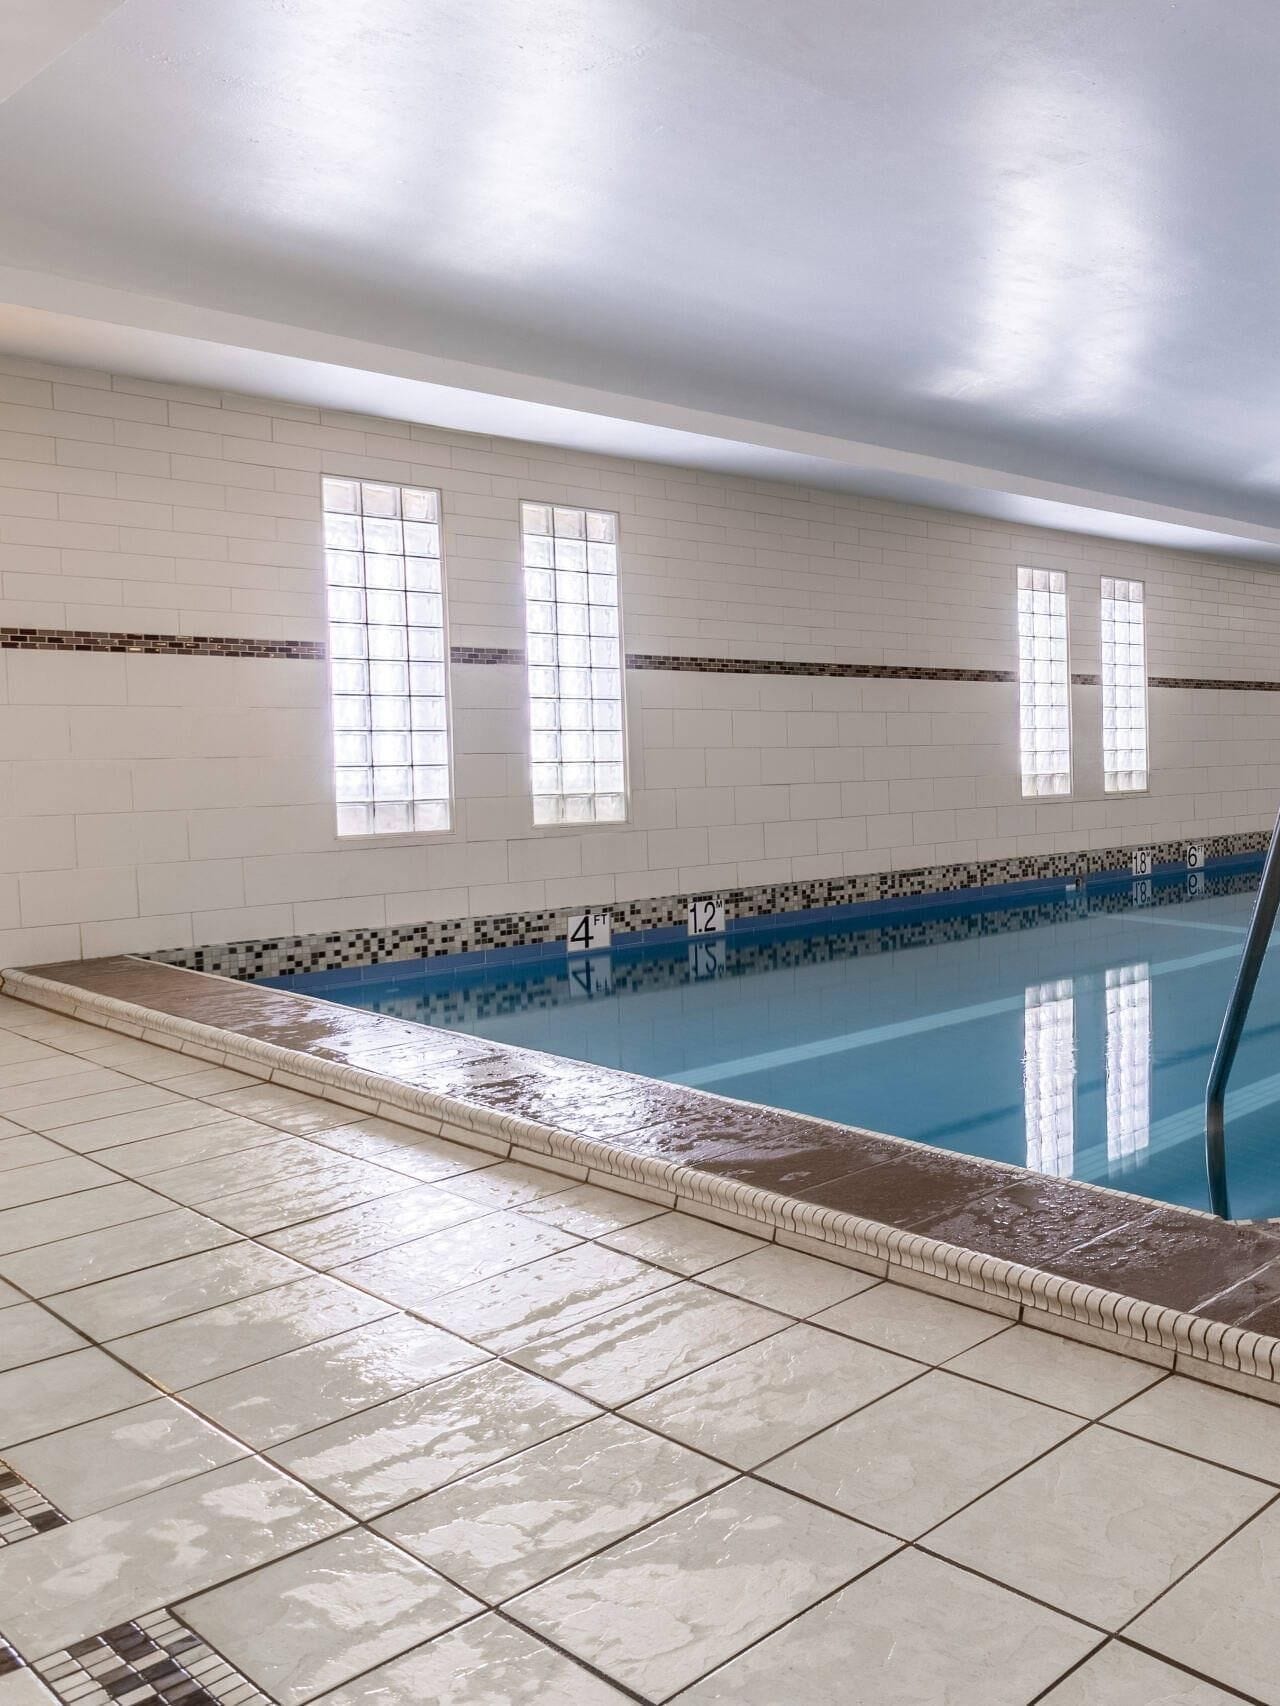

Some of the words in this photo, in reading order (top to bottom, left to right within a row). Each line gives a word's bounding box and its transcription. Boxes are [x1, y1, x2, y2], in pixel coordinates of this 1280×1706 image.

[1133, 852, 1147, 875] 1.8
[1188, 846, 1197, 867] 6
[570, 916, 594, 948] 4
[594, 914, 608, 926] FT
[690, 901, 716, 934] 1.2
[716, 900, 723, 909] M
